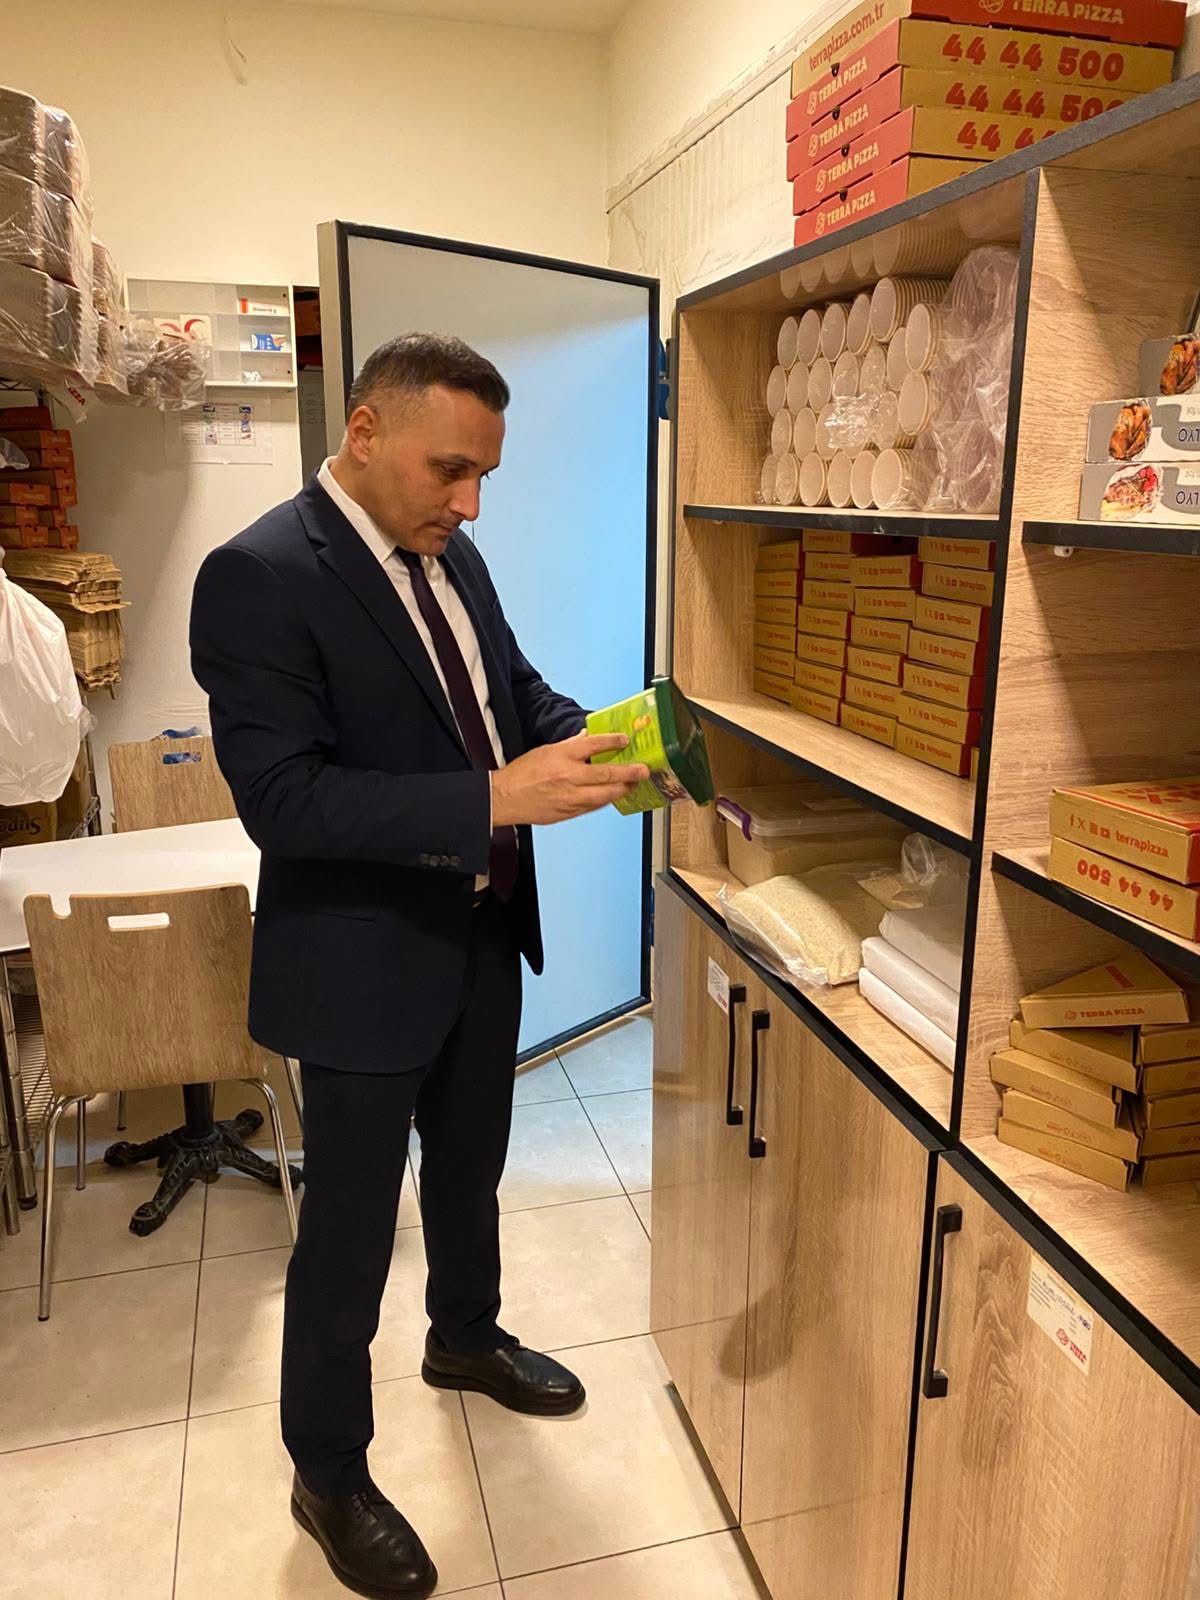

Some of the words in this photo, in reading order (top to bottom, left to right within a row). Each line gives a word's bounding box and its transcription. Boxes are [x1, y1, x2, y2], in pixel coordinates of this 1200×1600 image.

[1013, 0, 1070, 17] TERRA
[808, 2, 885, 71] terrapizza.com.tr
[942, 33, 987, 65] 44
[1000, 40, 1043, 72] 44
[1057, 46, 1124, 81] 500
[818, 75, 843, 103] TERRA
[945, 82, 989, 112] 44
[1002, 88, 1045, 118] 44
[819, 120, 844, 147] TERRA
[957, 121, 1001, 151] 44
[827, 157, 853, 184] TERRA
[826, 202, 852, 226] TERRA
[1115, 829, 1169, 858] terrapizza
[1076, 858, 1112, 887] 500
[1118, 876, 1142, 898] 44
[1149, 889, 1174, 911] 44
